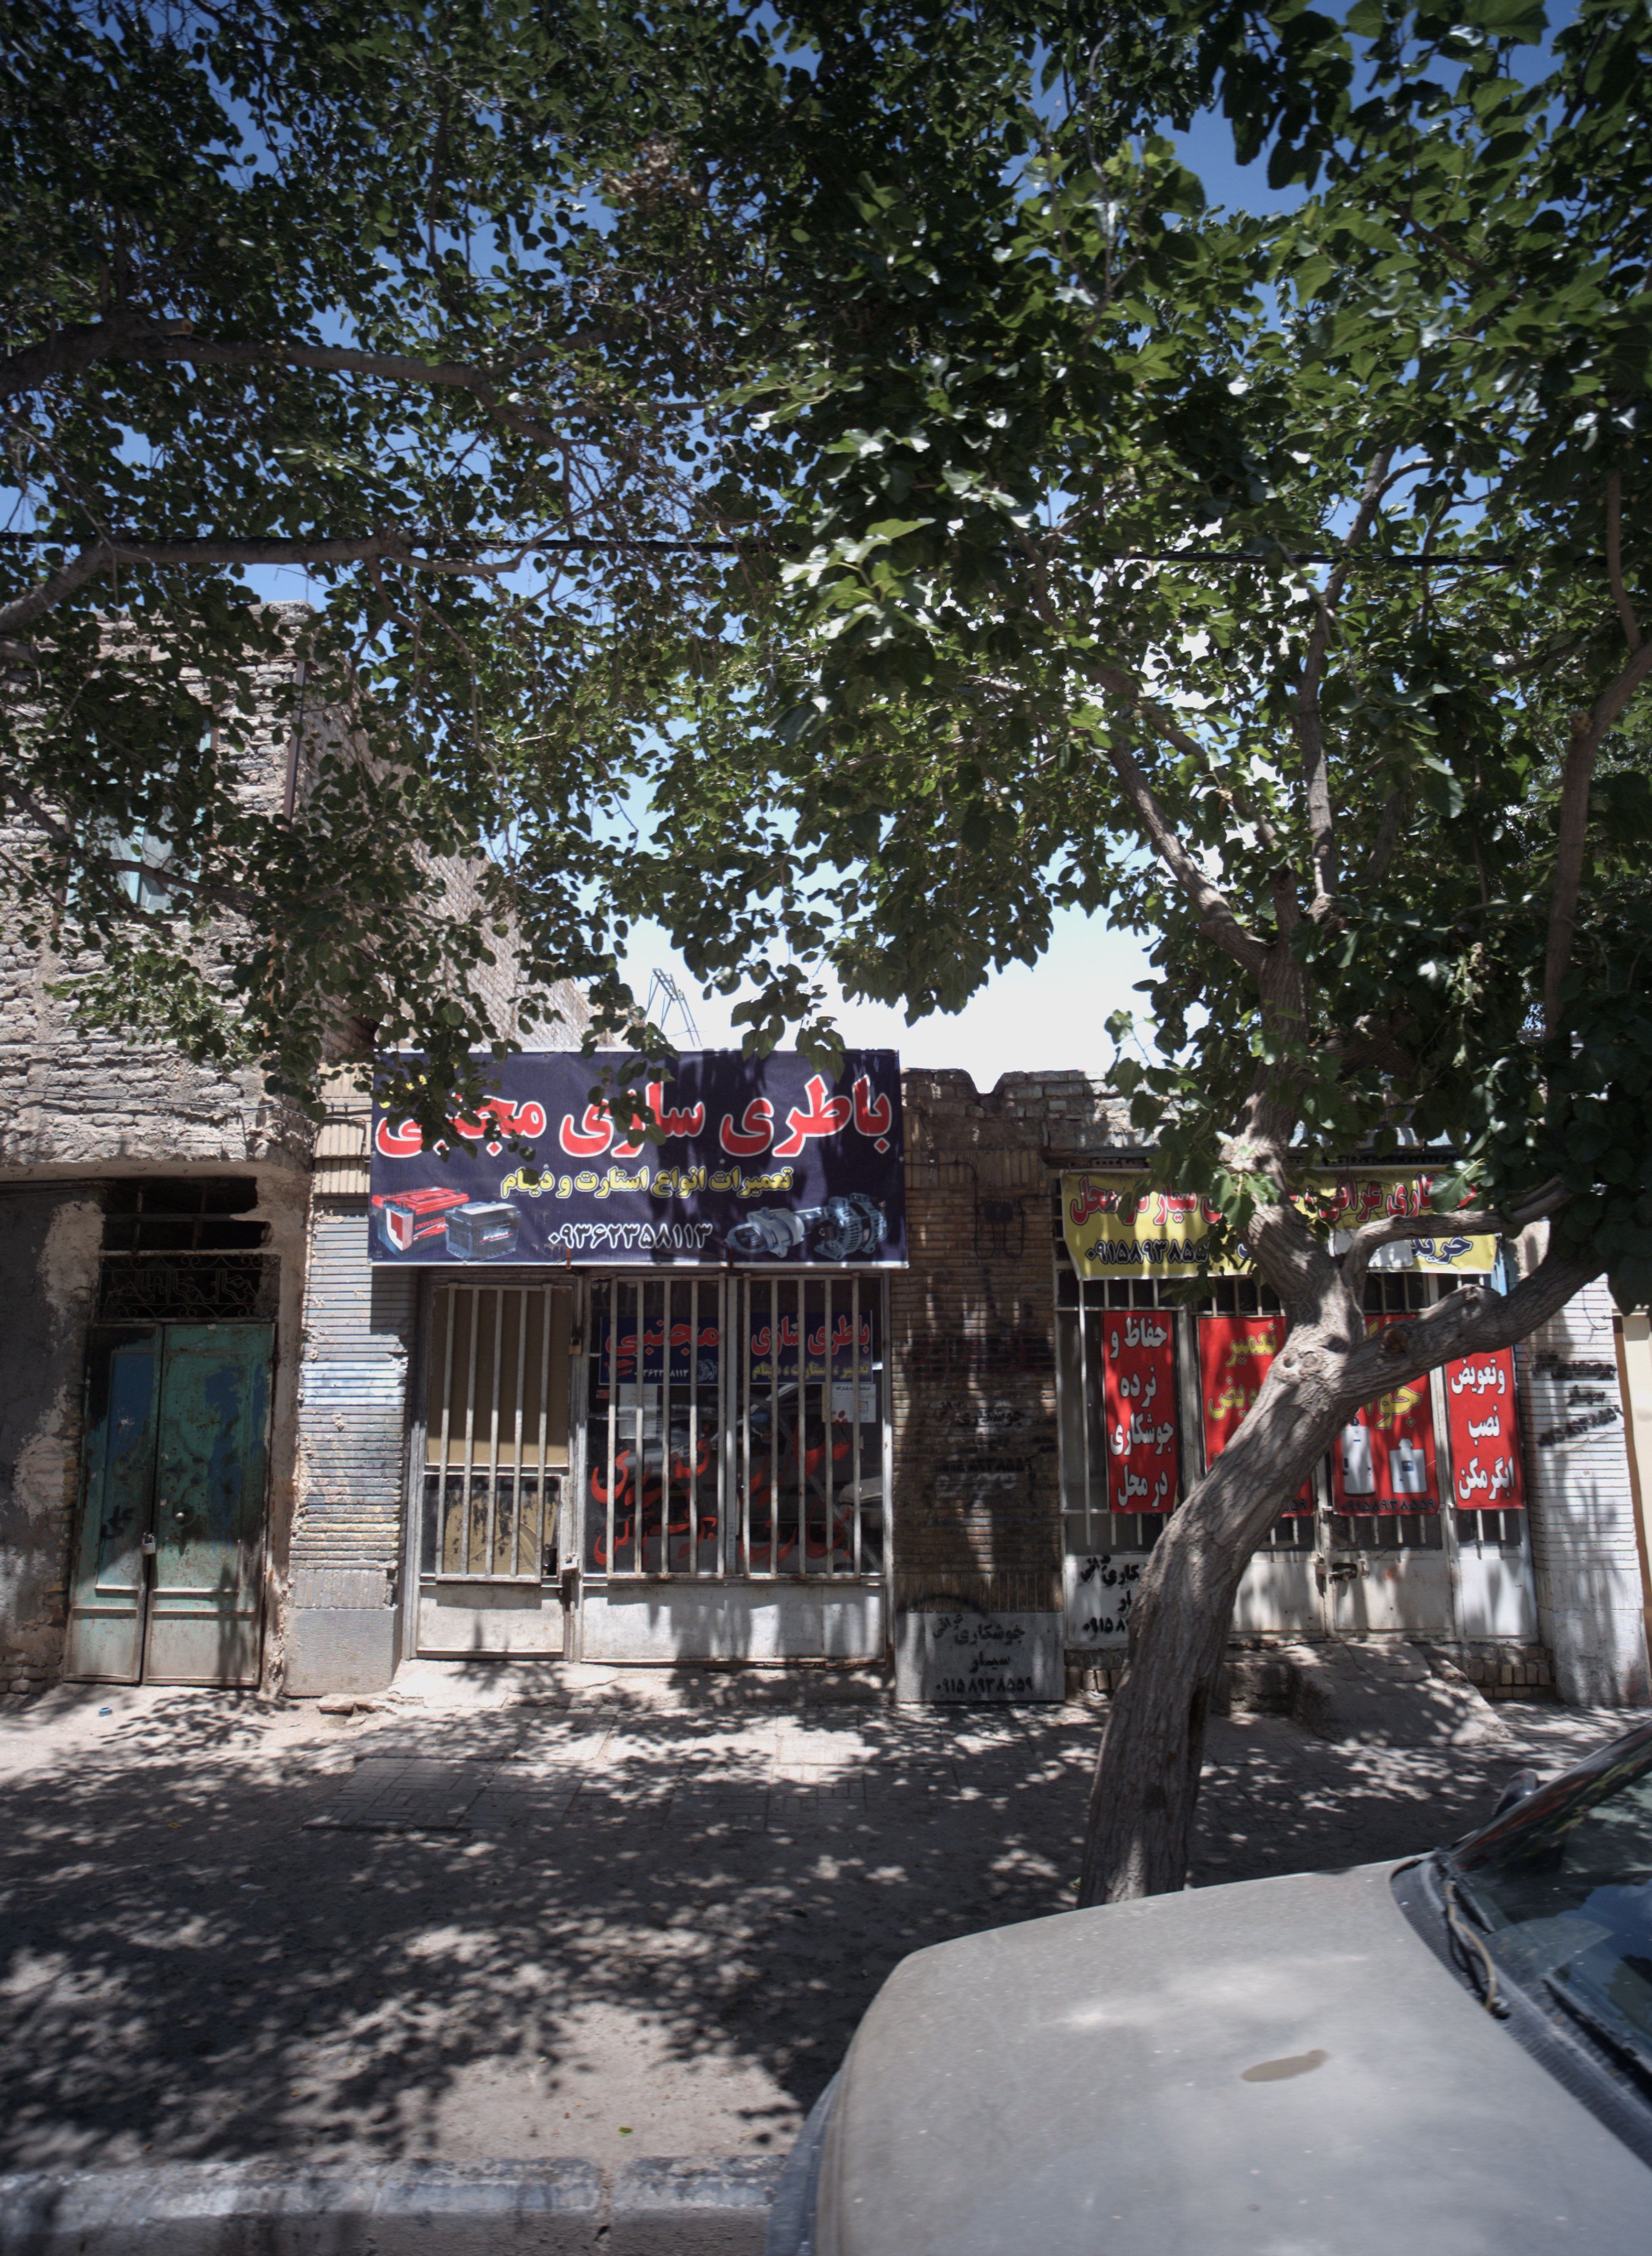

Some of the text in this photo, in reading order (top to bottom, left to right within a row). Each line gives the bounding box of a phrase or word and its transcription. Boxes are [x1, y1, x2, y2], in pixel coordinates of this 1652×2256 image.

[559, 1081, 706, 1158] سازی
[719, 1074, 892, 1158] باطری
[501, 1166, 794, 1199] تعمیرات انواع استارت و دینام
[1070, 1174, 1120, 1226] محل
[1153, 1183, 1198, 1225] سیار
[548, 1223, 713, 1249] ۰۹۳۶۲۳۵۸۱۱۳
[1085, 1239, 1211, 1263] ۰۹۱۵۸۹۳۸۵۵
[807, 1315, 870, 1355] باطری
[1109, 1316, 1168, 1359] حفاظ و
[1225, 1322, 1278, 1367] تعمیر
[634, 1369, 690, 1378] ۰۳۶۲۳۸۱۱۳
[1120, 1365, 1156, 1408] نرده
[1110, 1412, 1175, 1456] جوشکاری
[1468, 1404, 1501, 1446] نصب
[1117, 1463, 1169, 1507] در محل
[1341, 1498, 1436, 1514] ۰۹۱۵۸۹۳۸۵۵۹
